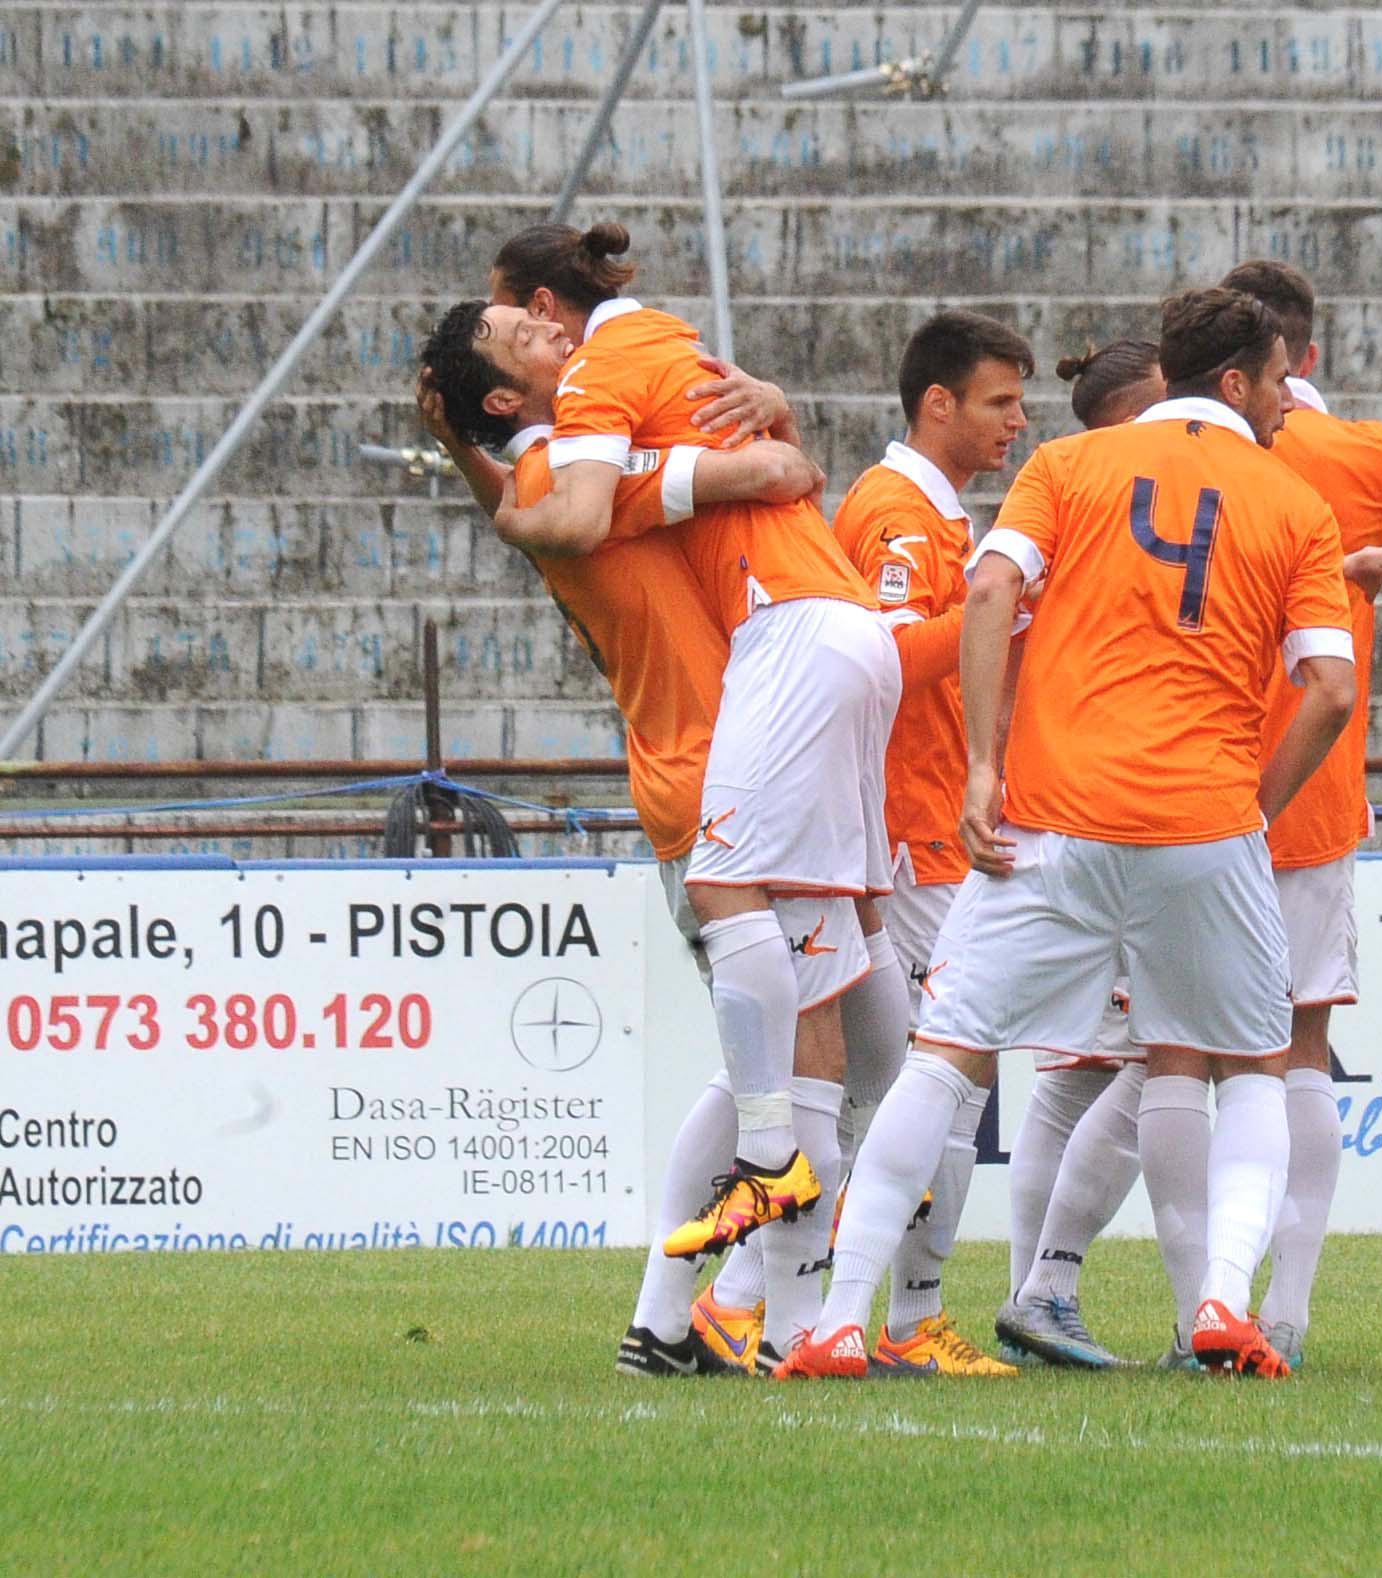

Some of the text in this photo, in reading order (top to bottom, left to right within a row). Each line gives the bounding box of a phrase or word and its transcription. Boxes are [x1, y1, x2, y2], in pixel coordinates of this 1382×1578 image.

[1129, 475, 1224, 632] 4
[219, 903, 285, 959] 10
[309, 932, 327, 944] -
[348, 902, 601, 958] PISTOIA
[7, 993, 433, 1051] 0573 380.120
[0, 1108, 118, 1148] Centro
[328, 1086, 604, 1132] Dasa-Rägister
[331, 1134, 609, 1161] EN ISO 14001:2004
[0, 1165, 203, 1206] Autorizzato
[462, 1169, 608, 1195] IE-0811-11
[1, 1222, 249, 1253] Certificazione
[258, 1222, 293, 1252] di
[436, 1220, 497, 1249] ISO
